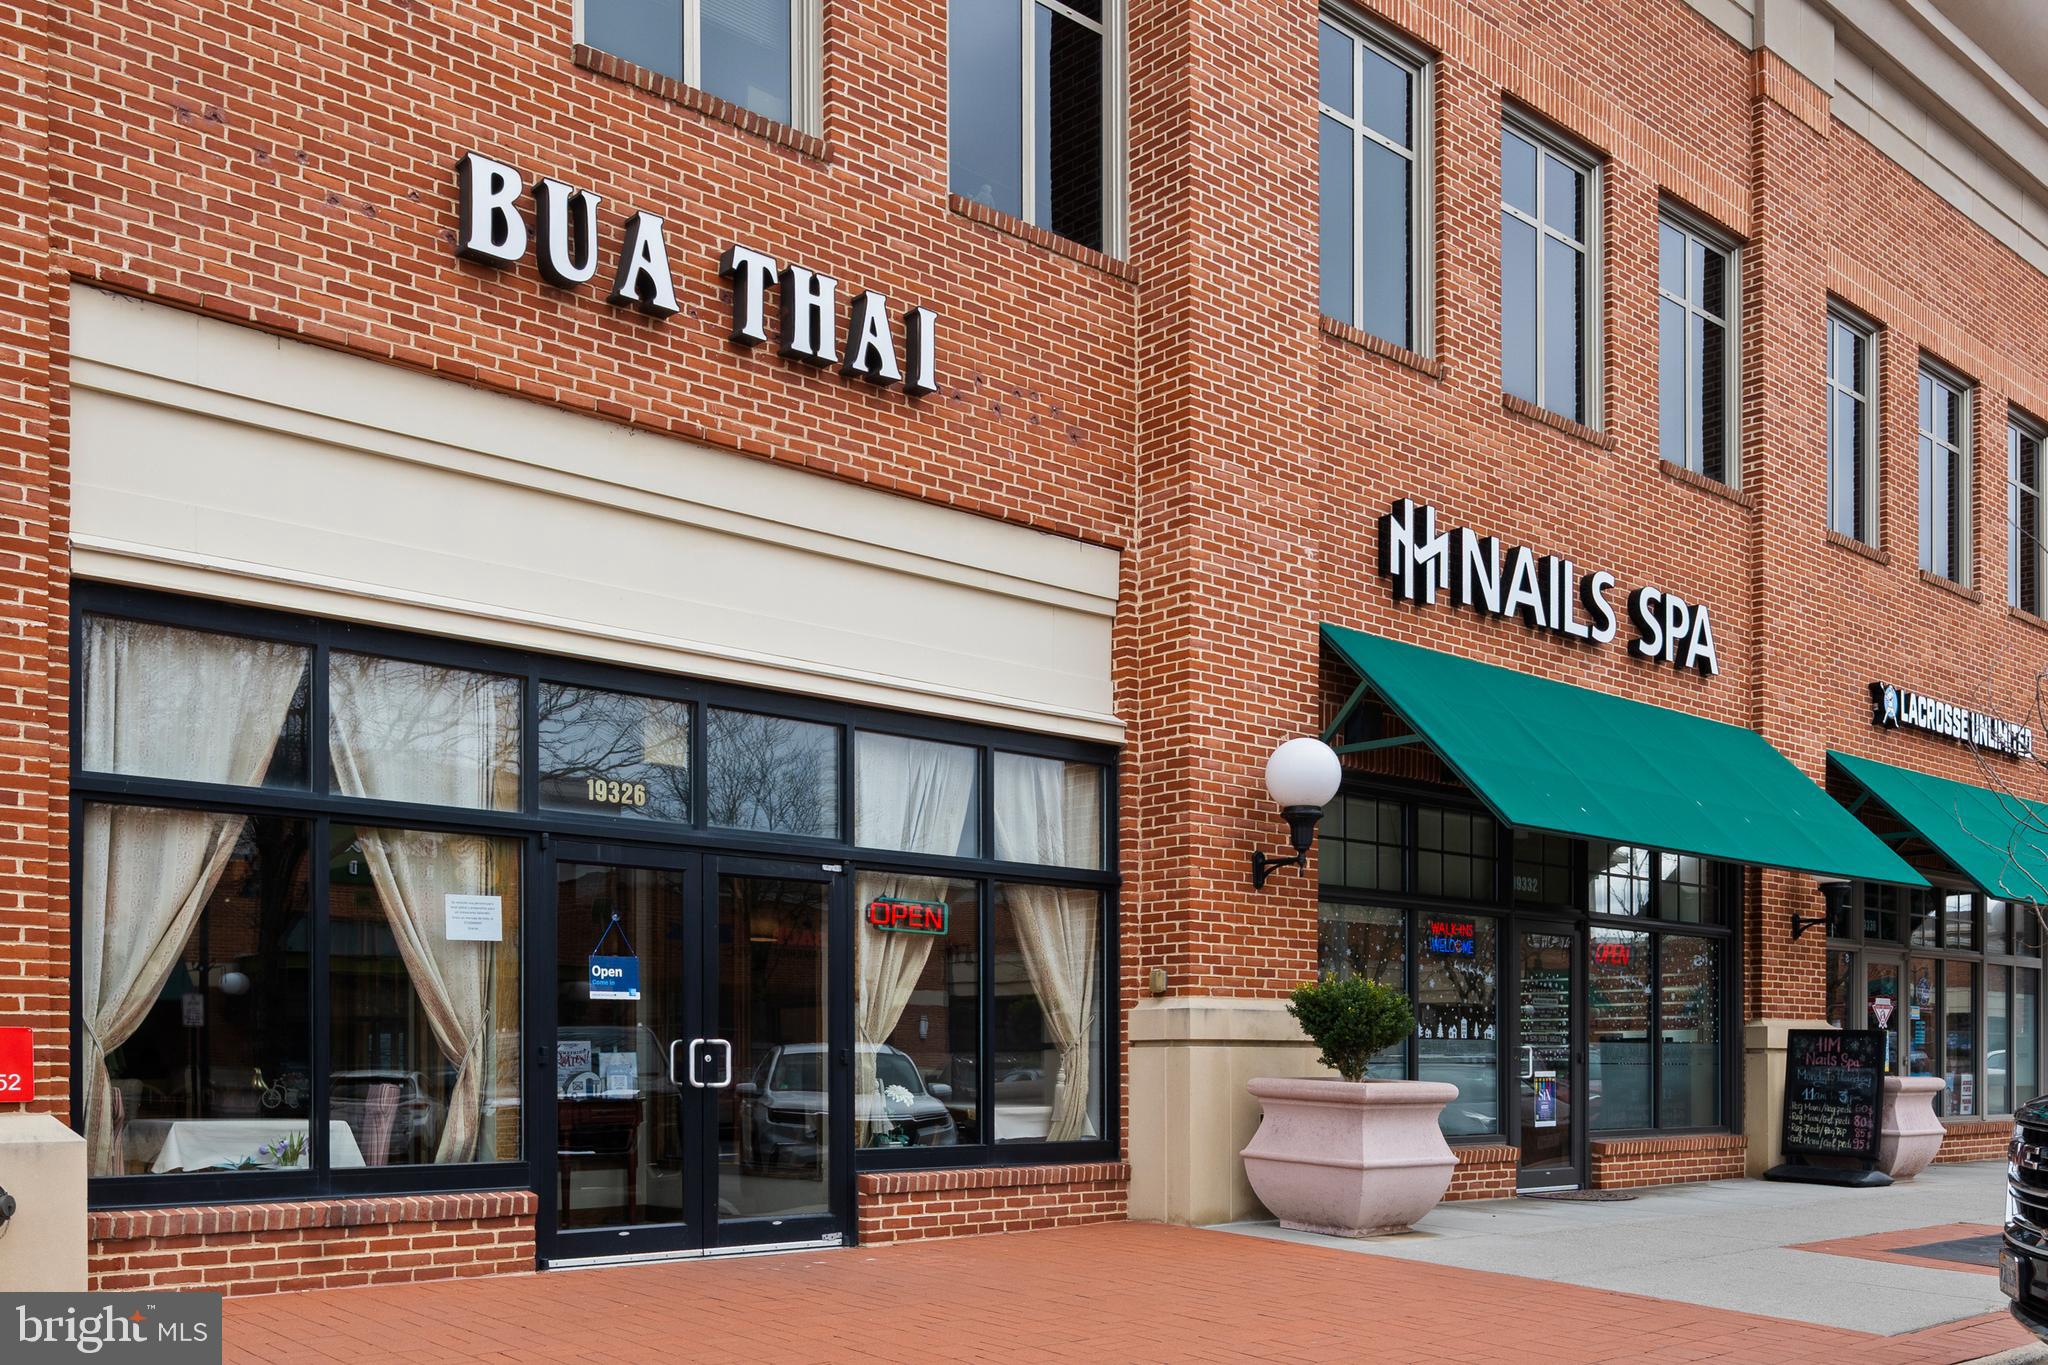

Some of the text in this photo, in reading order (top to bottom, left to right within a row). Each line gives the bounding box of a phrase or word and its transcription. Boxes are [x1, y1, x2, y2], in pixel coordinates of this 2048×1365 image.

[460, 151, 938, 396] BUA THAI
[1457, 526, 1617, 644] NAILS
[1632, 586, 1720, 676] SPA
[1901, 689, 2033, 759] LACROSSE UNLIMITED
[586, 779, 647, 807] 19326
[870, 902, 943, 930] OPEN
[1431, 921, 1473, 938] WALK-INS
[1431, 937, 1474, 955] WELCOME
[1595, 943, 1631, 967] OPEN
[592, 965, 623, 980] Open
[1805, 1052, 1862, 1072] Nails Spa
[0, 1073, 21, 1091] 52
